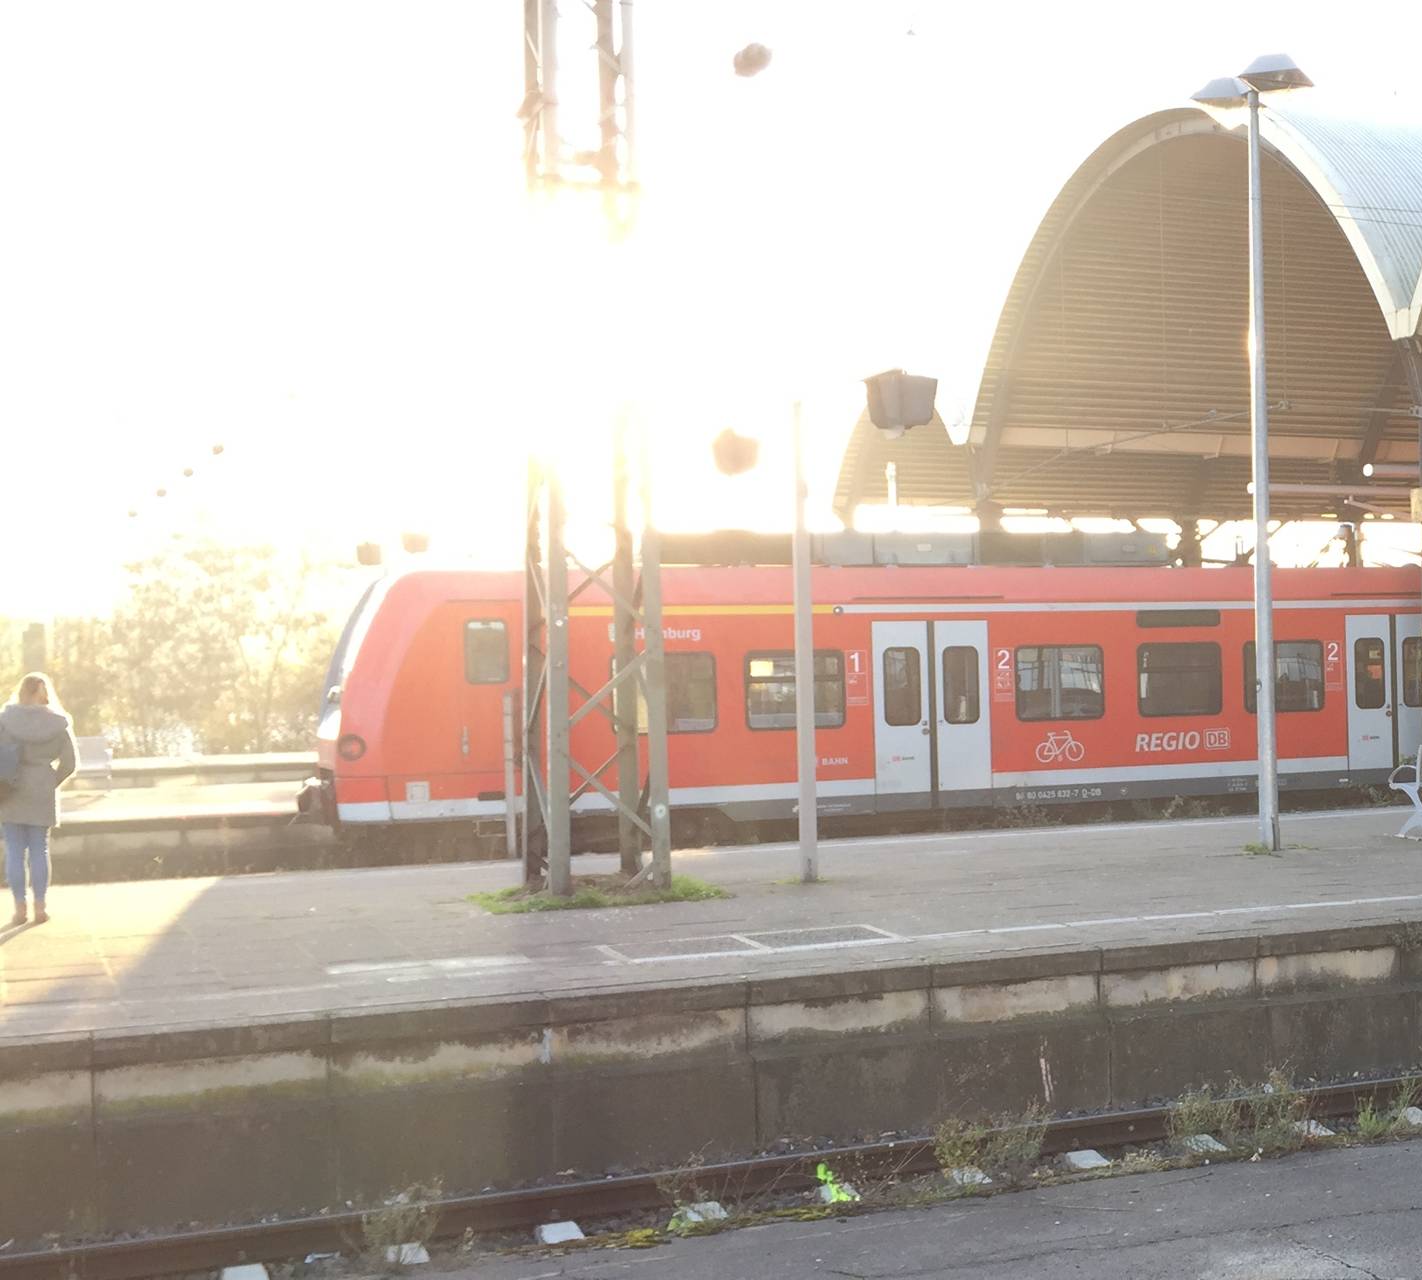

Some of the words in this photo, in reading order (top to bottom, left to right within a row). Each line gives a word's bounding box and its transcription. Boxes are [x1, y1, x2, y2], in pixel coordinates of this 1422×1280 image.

[634, 627, 701, 641] Hburg
[997, 649, 1010, 669] 2
[1327, 642, 1339, 661] 2
[849, 652, 860, 673] 1
[1135, 731, 1200, 752] REGIO
[1206, 730, 1229, 748] DB
